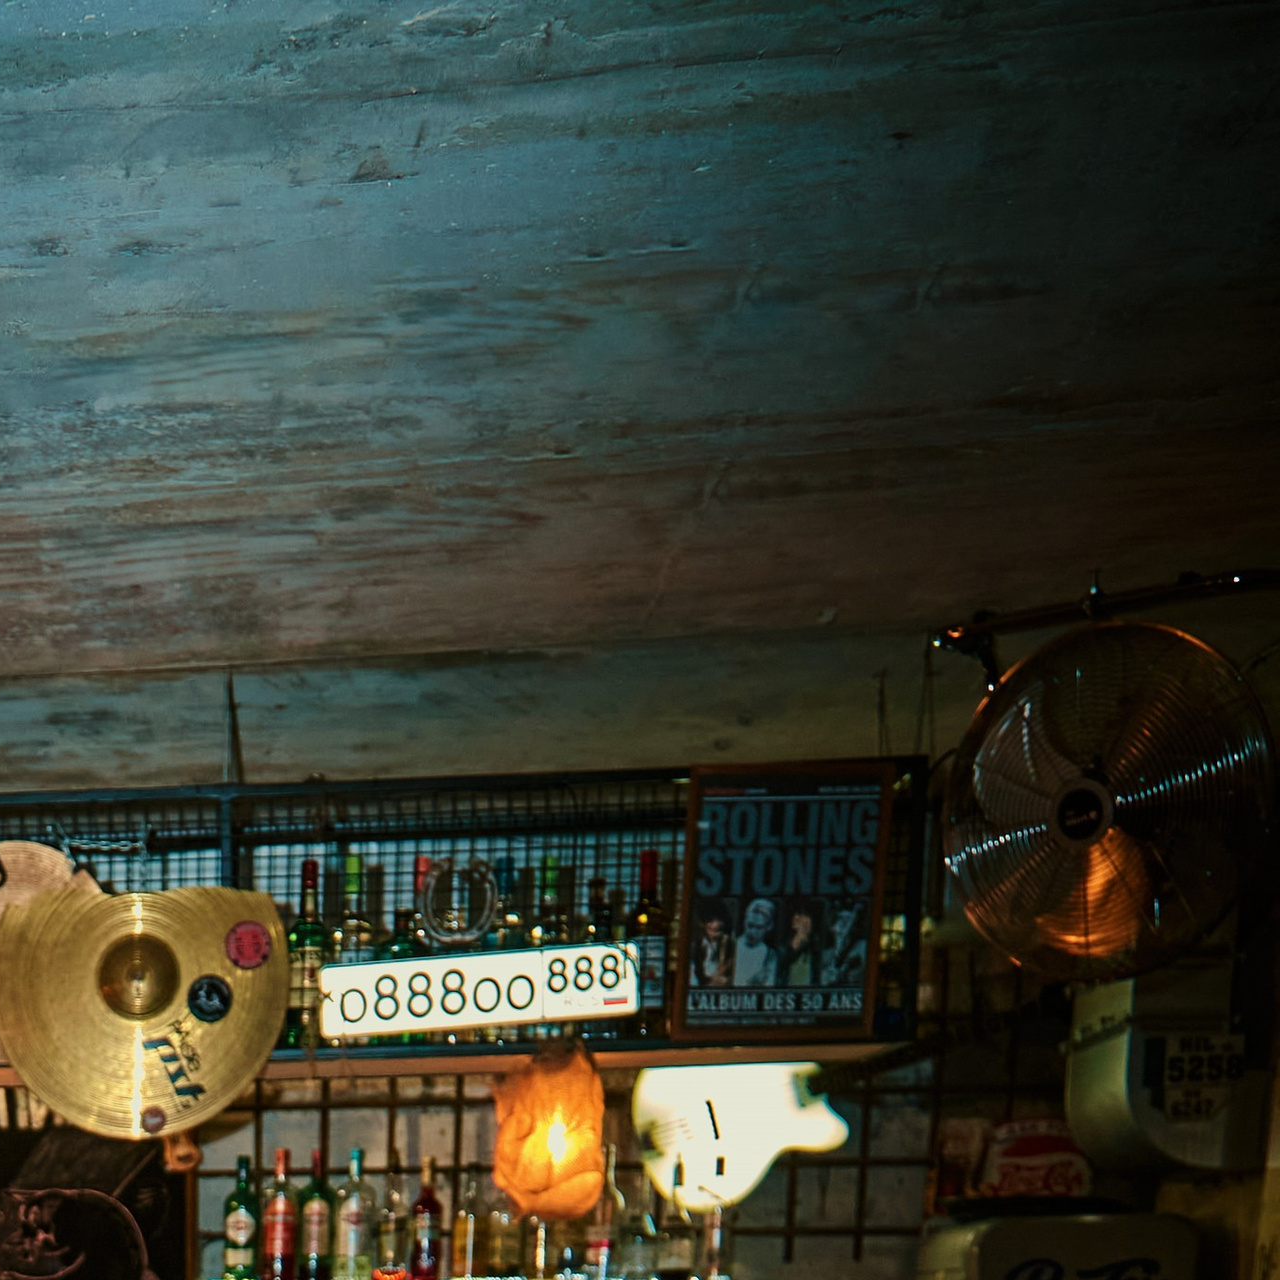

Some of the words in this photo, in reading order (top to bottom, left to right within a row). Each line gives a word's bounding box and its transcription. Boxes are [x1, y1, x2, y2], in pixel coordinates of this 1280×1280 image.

[700, 801, 880, 847] ROLLING
[694, 847, 876, 896] STONES
[687, 993, 758, 1012] L'ALBUM
[763, 992, 797, 1011] DES
[829, 991, 863, 1010] ANS
